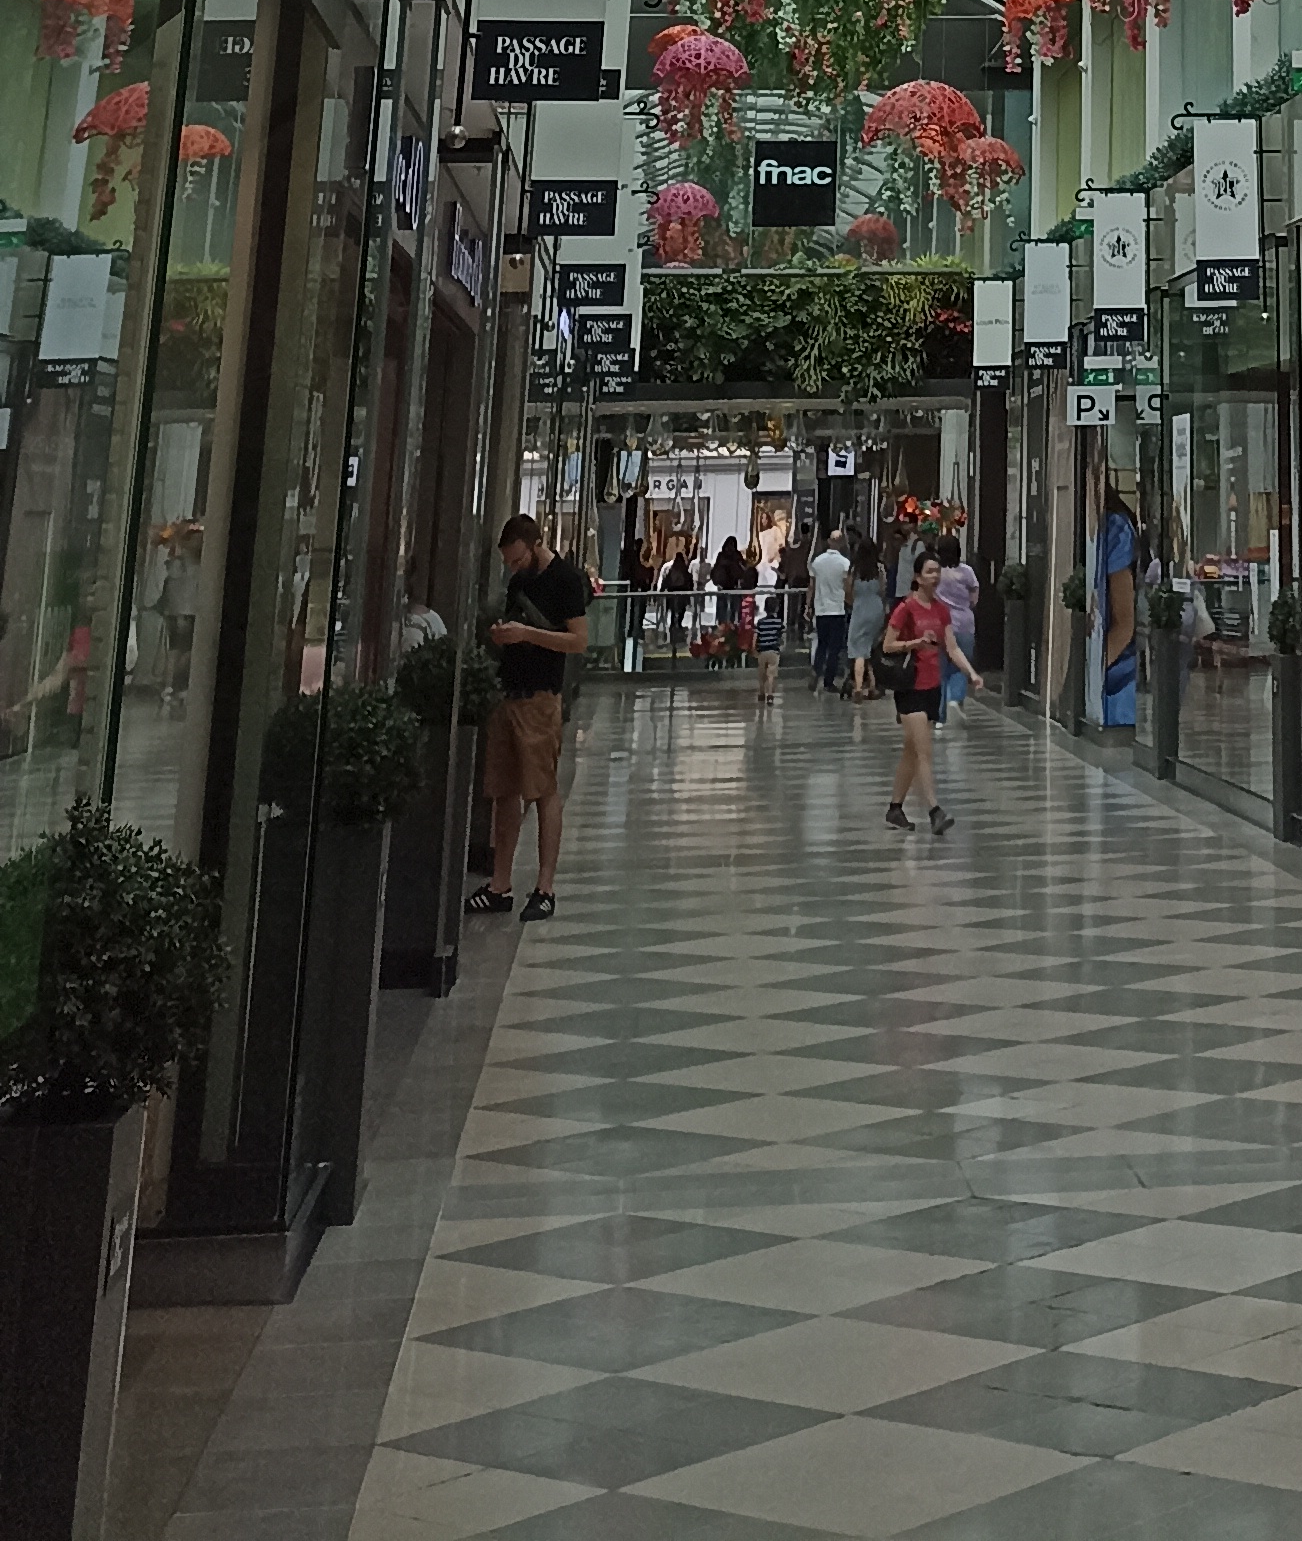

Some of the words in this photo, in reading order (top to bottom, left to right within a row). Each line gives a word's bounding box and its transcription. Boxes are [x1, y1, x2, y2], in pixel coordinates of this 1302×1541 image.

[496, 36, 588, 55] PASSAGE
[507, 52, 540, 70] DU
[489, 67, 560, 86] HAVRE
[757, 159, 833, 185] fnac
[543, 190, 607, 204] PASSAGE
[539, 212, 588, 226] HAVRE
[1206, 266, 1252, 277] PASSAGE
[1076, 394, 1096, 421] P
